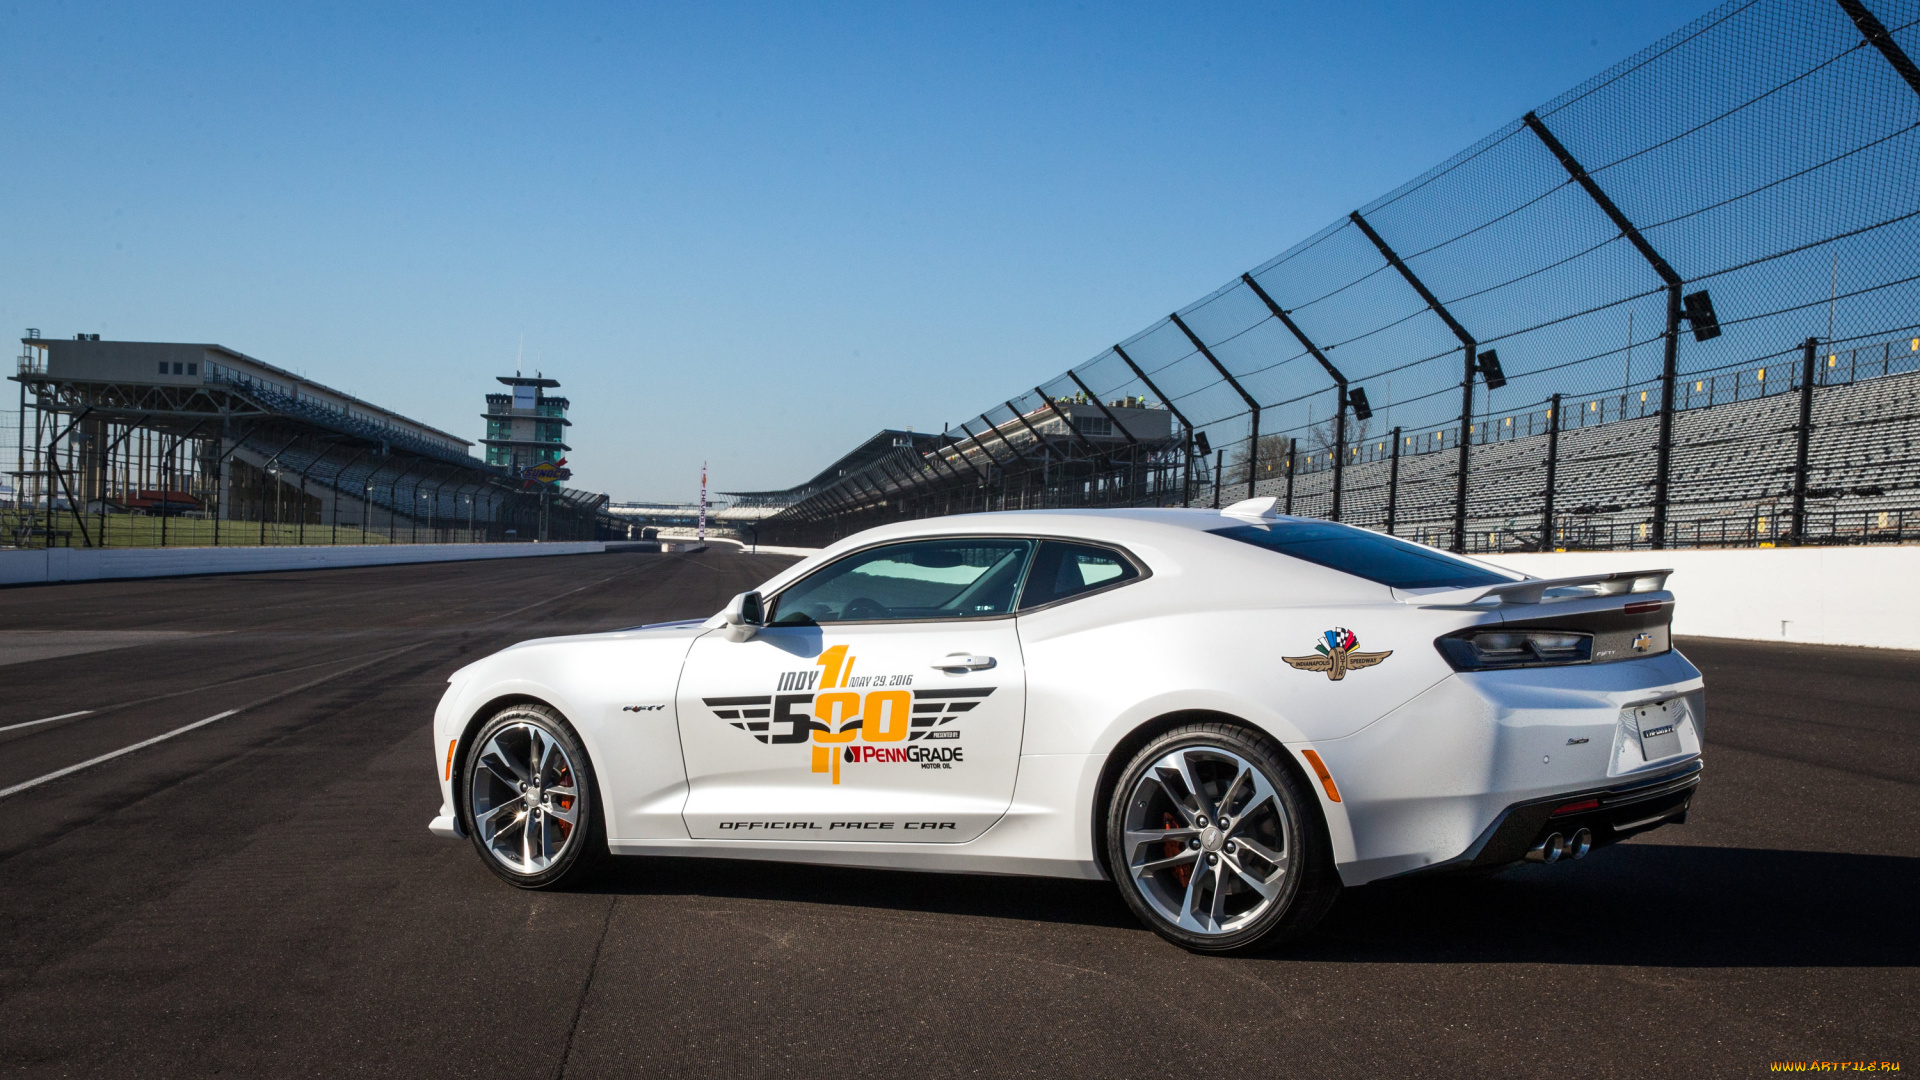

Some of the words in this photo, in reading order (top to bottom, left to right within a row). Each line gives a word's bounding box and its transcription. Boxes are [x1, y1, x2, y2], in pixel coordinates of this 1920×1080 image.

[525, 469, 568, 479] SUNOCO
[1295, 659, 1331, 667] INDIANAPOLIS
[1338, 650, 1346, 676] MOTOR
[1349, 657, 1377, 665] SPEEDWAY
[776, 670, 819, 691] INDY
[848, 676, 872, 688] MAY
[889, 674, 914, 686] 2016
[772, 690, 911, 744] 500
[719, 821, 823, 831] OFFICIAL
[829, 821, 895, 831] PACE
[903, 821, 957, 830] CAR
